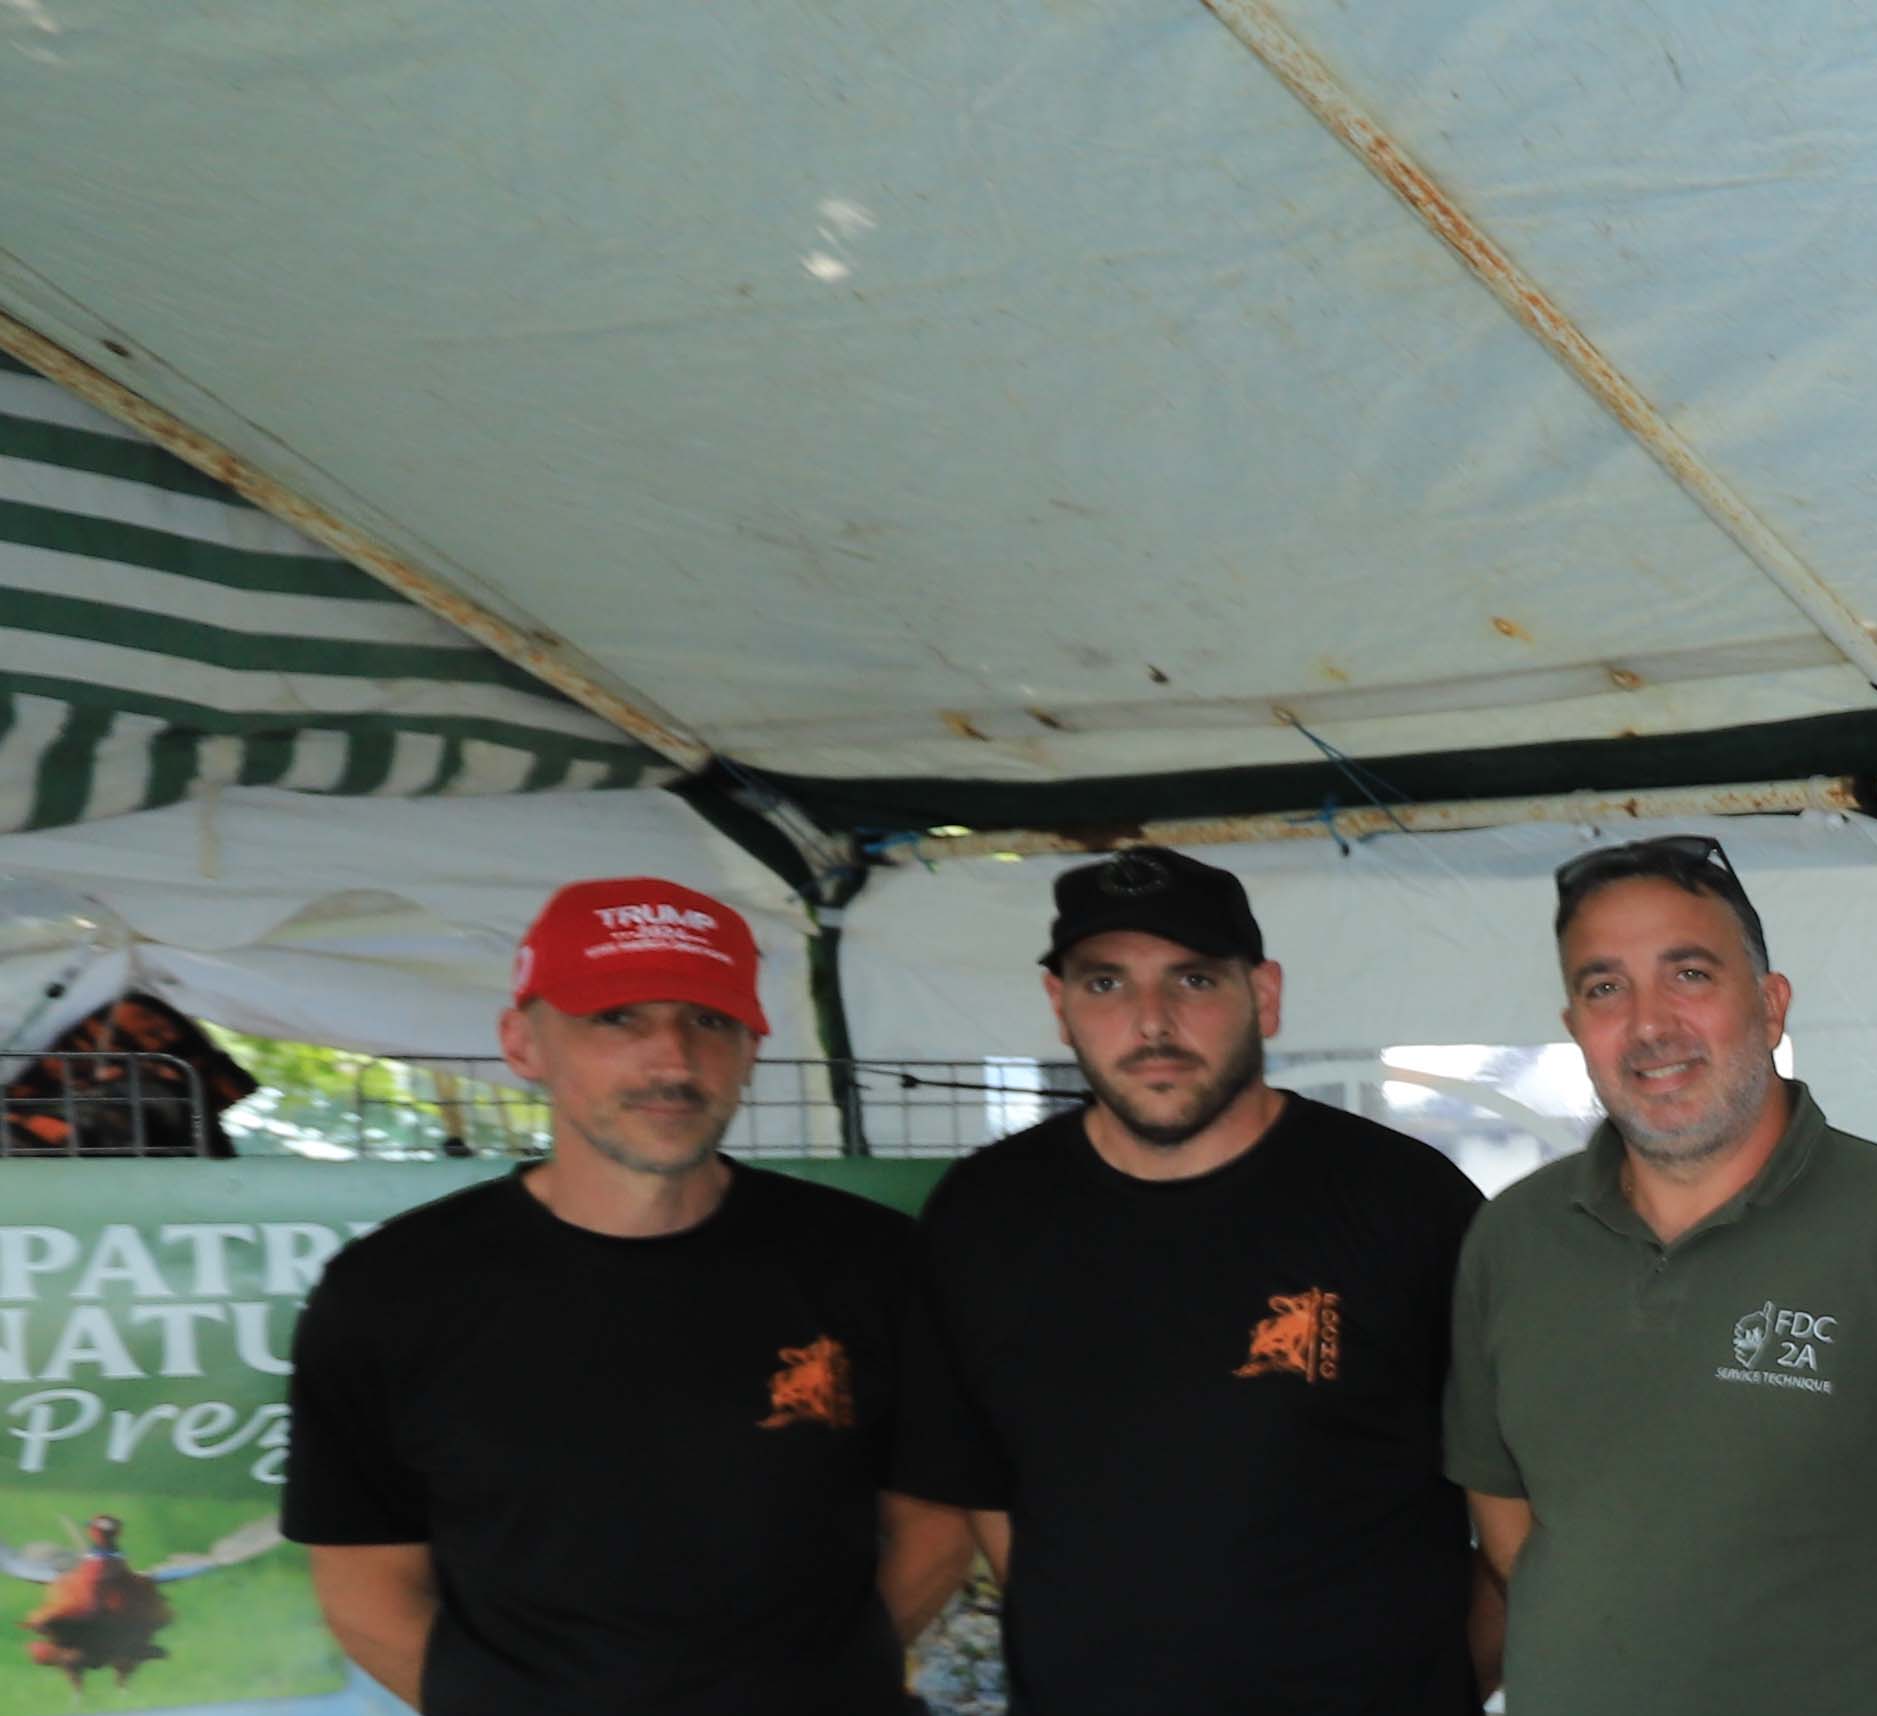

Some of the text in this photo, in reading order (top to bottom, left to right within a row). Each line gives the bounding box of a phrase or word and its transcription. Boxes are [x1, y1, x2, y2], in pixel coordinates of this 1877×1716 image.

[594, 904, 719, 931] TRUMP
[0, 1222, 384, 1299] PATR
[1775, 1310, 1838, 1343] FDC
[1777, 1342, 1817, 1371] 2A
[1715, 1367, 1833, 1394] SERVICE TECHNIQUE
